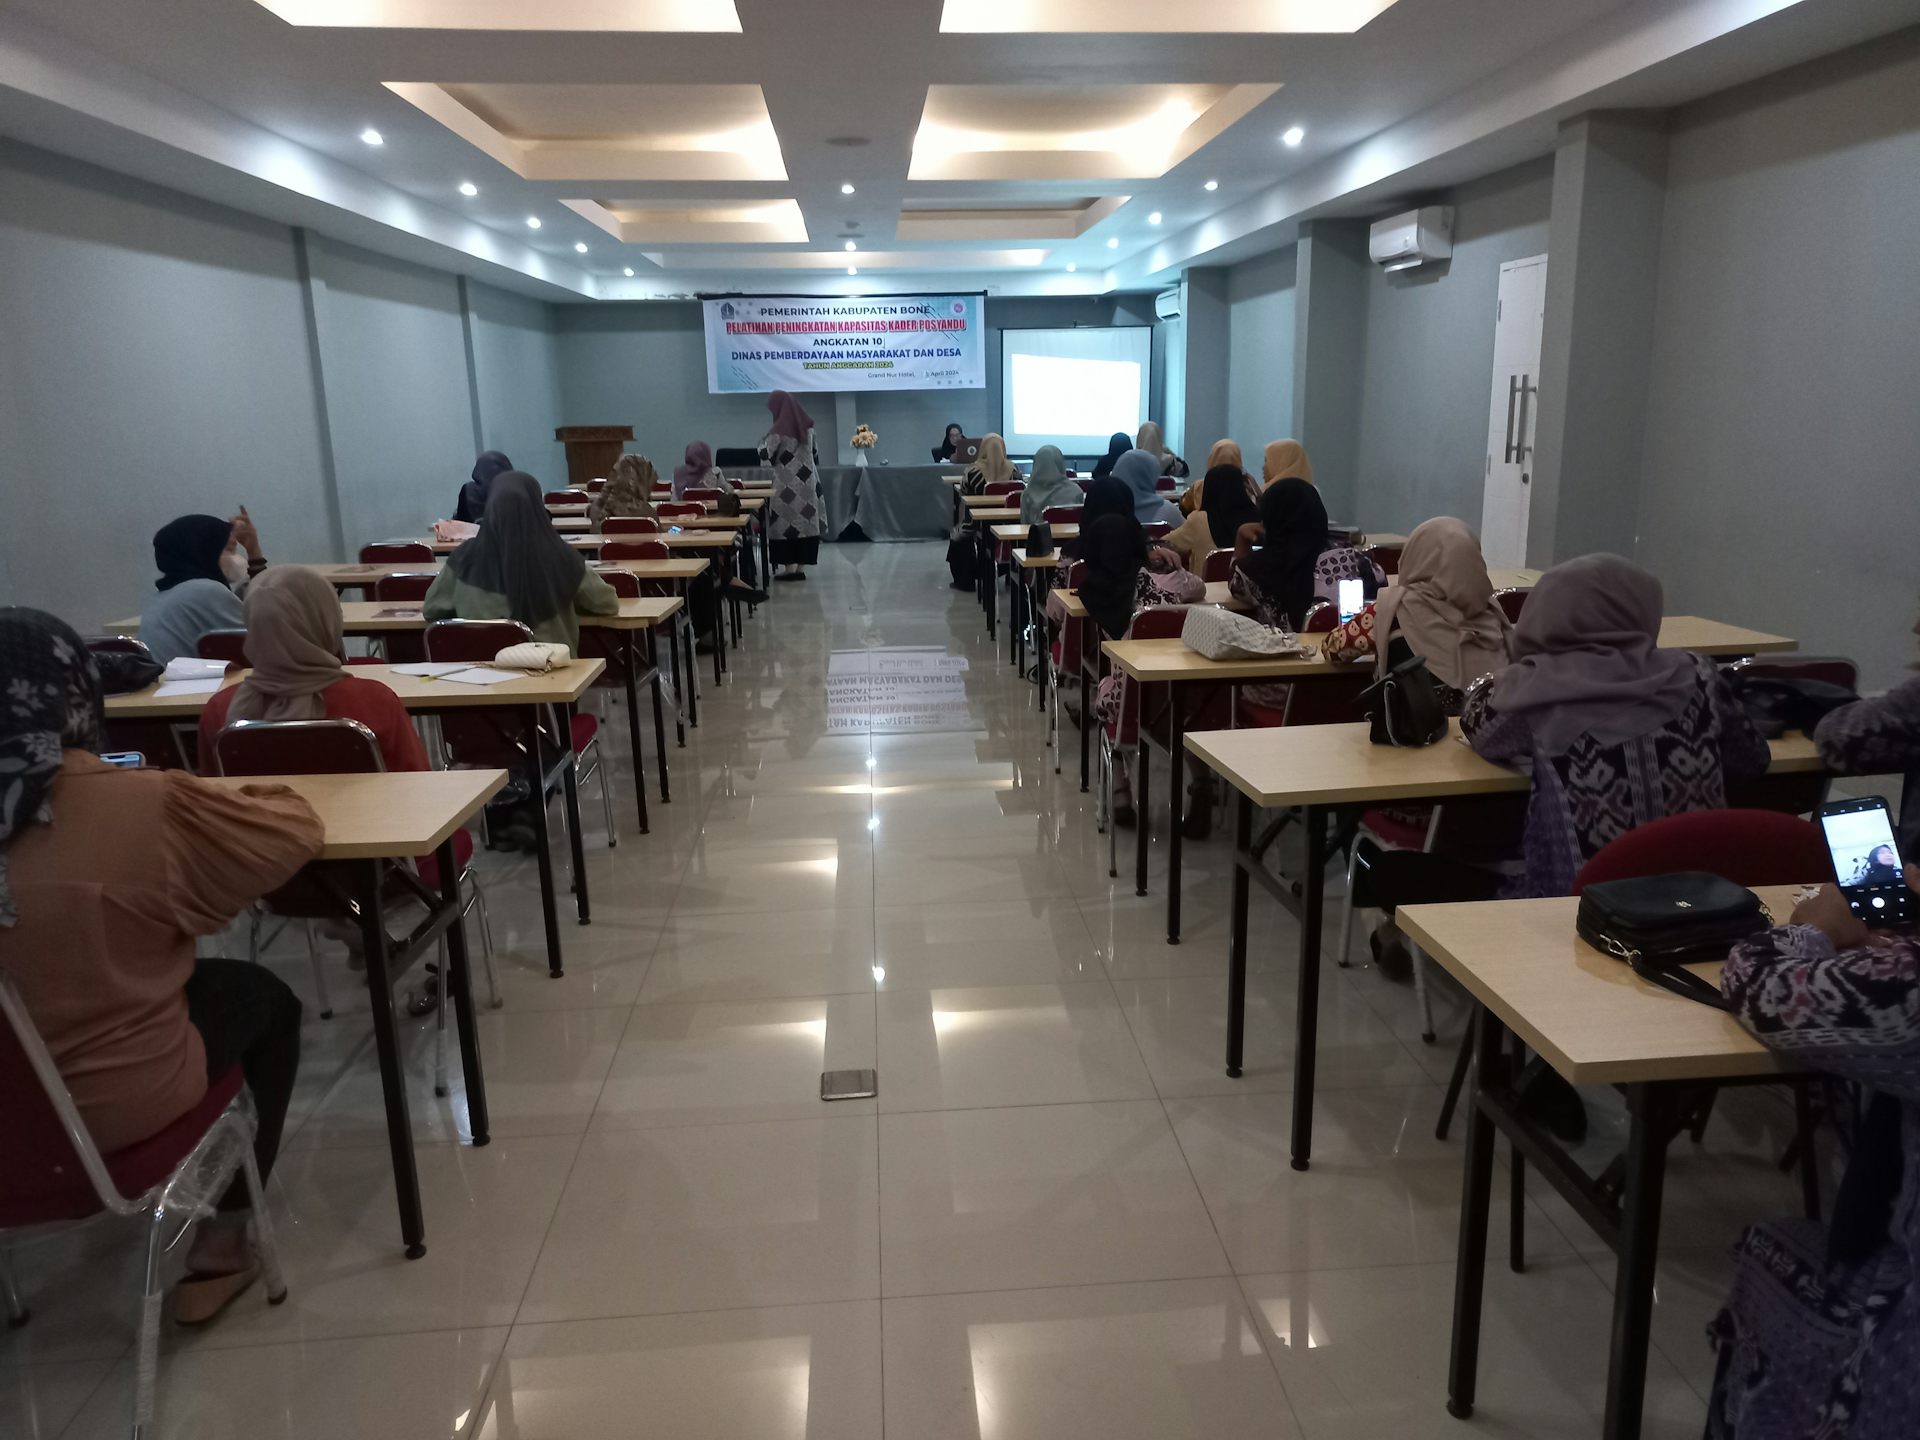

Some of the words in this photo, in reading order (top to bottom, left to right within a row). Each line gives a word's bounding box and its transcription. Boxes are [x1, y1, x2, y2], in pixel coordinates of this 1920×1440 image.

[761, 307, 830, 316] PEMERINTAH
[833, 307, 897, 315] KABUPATEN
[900, 306, 931, 314] BONE
[726, 321, 775, 334] PELATIHAN
[776, 321, 837, 334] PENINGKATAN
[838, 320, 888, 333] KAPASITAS
[888, 319, 918, 332] KADER
[919, 318, 966, 332] POSYANDU
[813, 338, 868, 346] ANGKATAN
[731, 351, 762, 360] DINAS
[764, 350, 844, 360] PEMBERDAYAAN
[846, 349, 911, 359] MASYARAKAT
[913, 348, 934, 357] DAN
[937, 348, 962, 357] DESA
[803, 362, 830, 370] TAHUN
[831, 361, 874, 370] ANGGARAN
[875, 360, 894, 369] 2024
